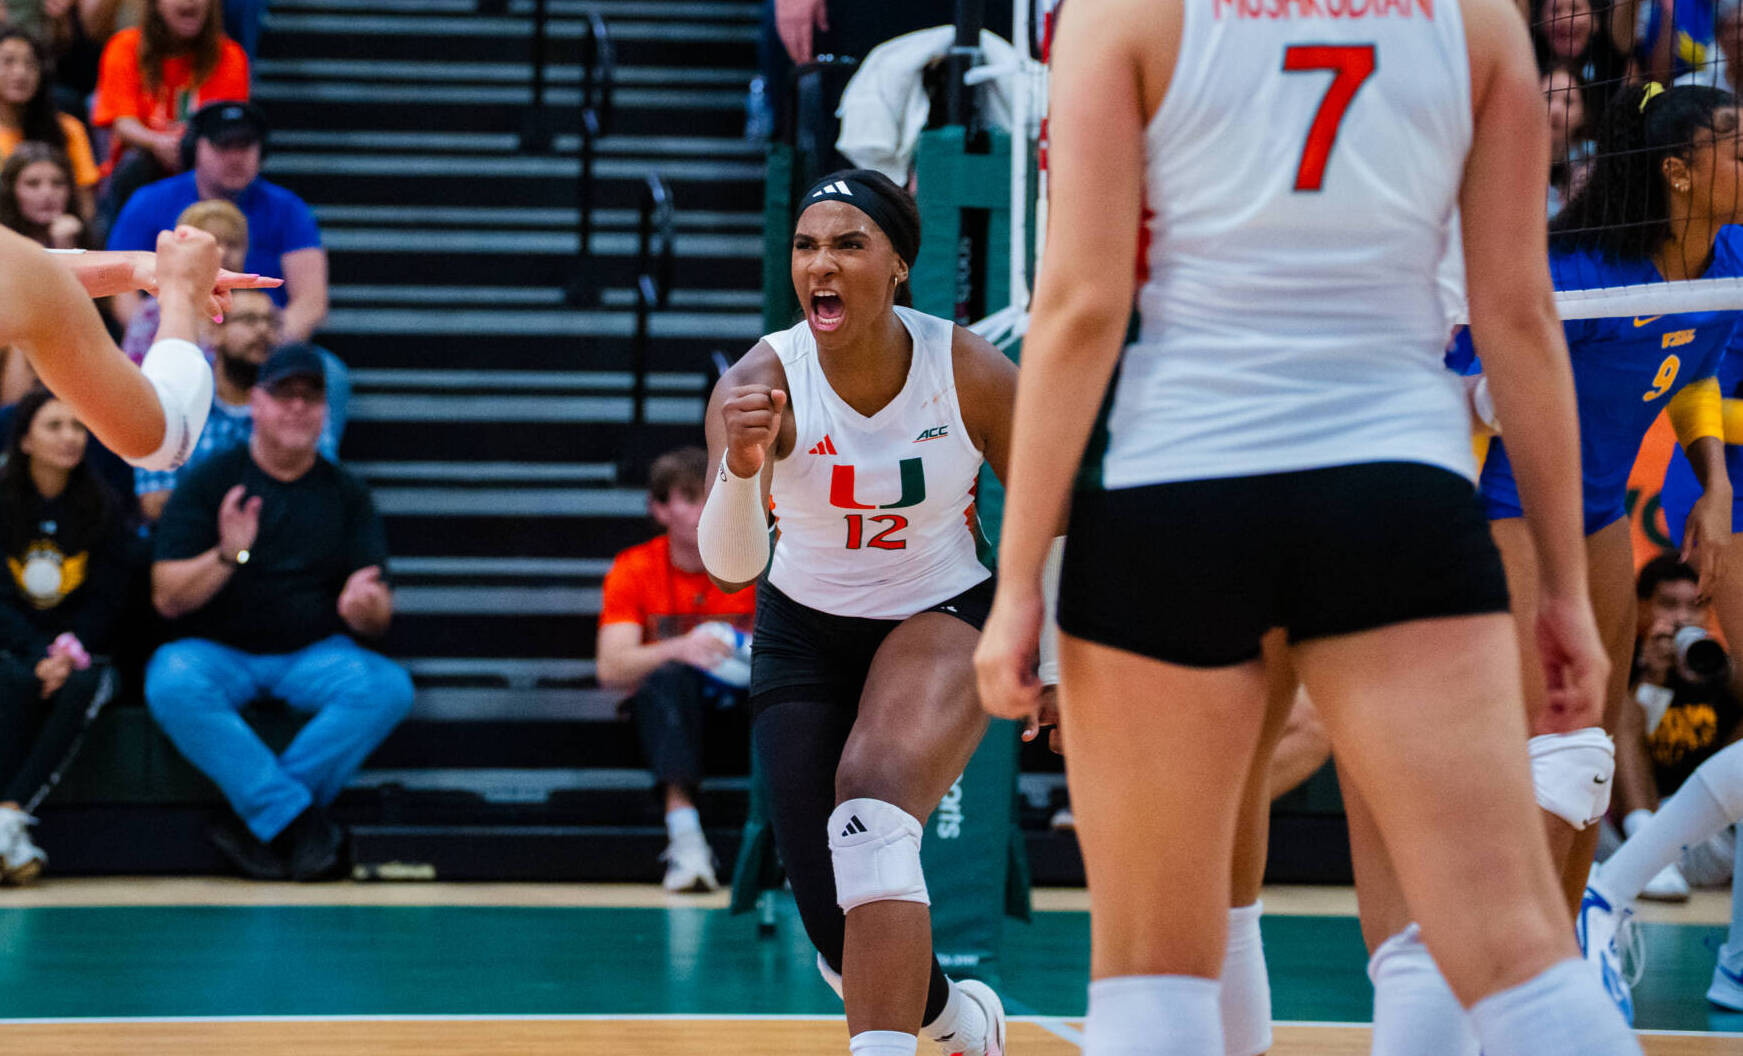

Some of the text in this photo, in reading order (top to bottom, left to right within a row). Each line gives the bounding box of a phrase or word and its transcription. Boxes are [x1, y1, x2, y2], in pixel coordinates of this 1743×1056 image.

[1281, 42, 1378, 194] 7
[1643, 354, 1681, 402] 9
[915, 424, 949, 441] ACC
[829, 457, 926, 510] U
[844, 514, 909, 549] 12
